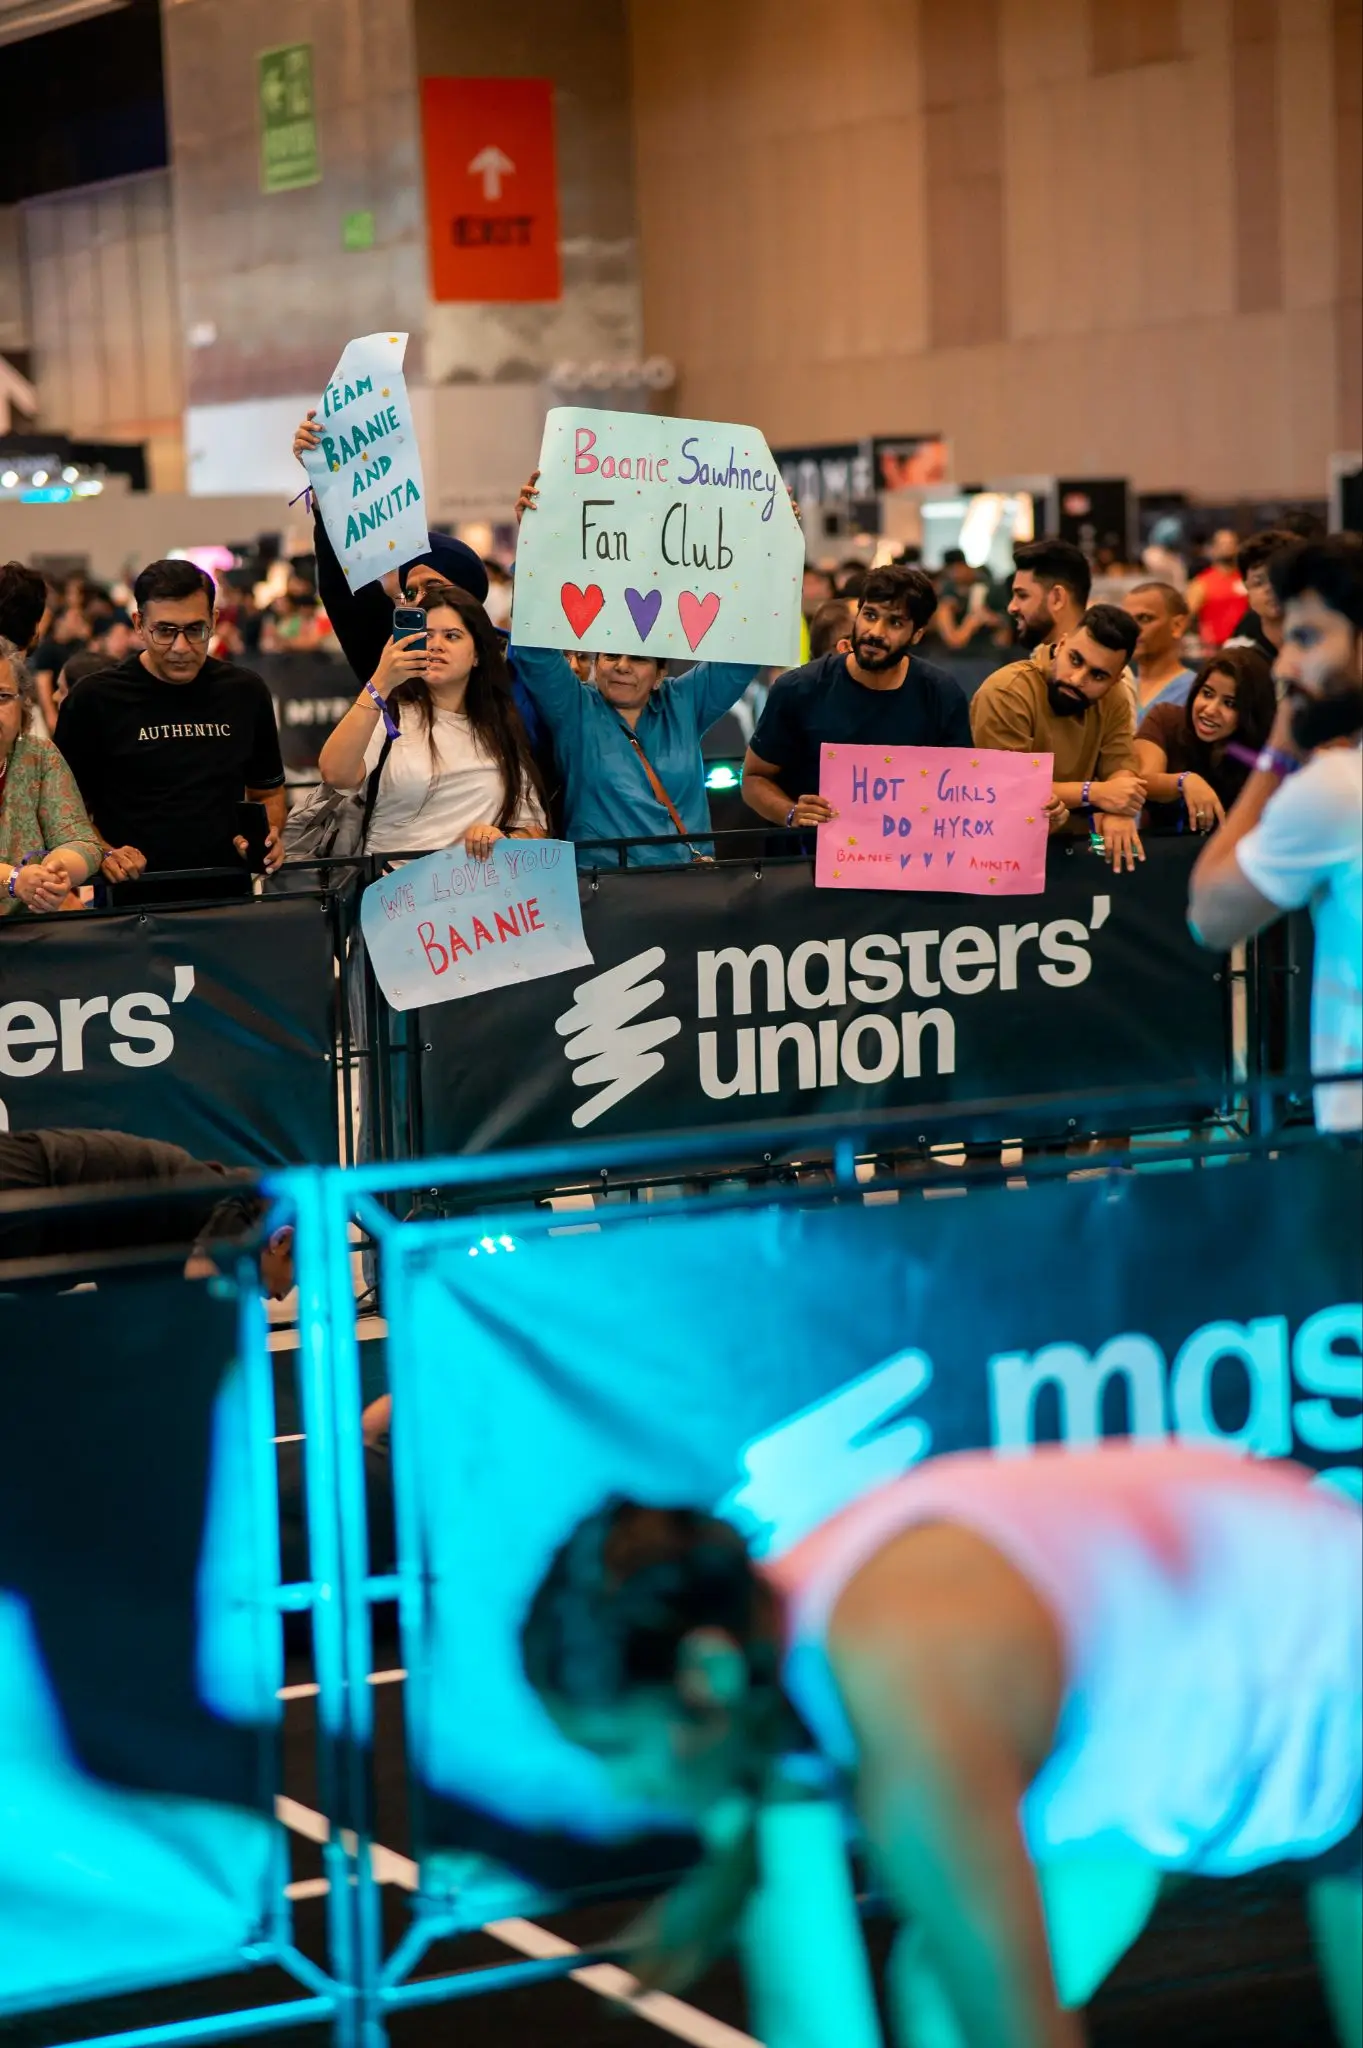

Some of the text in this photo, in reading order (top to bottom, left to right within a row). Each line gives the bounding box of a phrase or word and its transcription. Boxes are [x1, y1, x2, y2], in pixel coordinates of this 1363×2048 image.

[452, 214, 533, 248] EXIT
[322, 375, 374, 418] TEAM
[321, 405, 400, 472] BAANIE
[352, 455, 393, 498] AND
[574, 428, 669, 483] Baanie
[677, 437, 777, 522] Sawhney
[345, 478, 421, 549] ANKITA
[582, 500, 733, 570] Fan Club
[138, 723, 231, 740] AUTHENTIC
[851, 764, 996, 804] HOT GIRLS
[882, 814, 994, 839] DO HYROX
[380, 847, 562, 921] WE LOVE YOU
[836, 848, 1021, 871] BAANIE ANKITA
[417, 897, 546, 976] BAANIE
[698, 1007, 956, 1100] union
